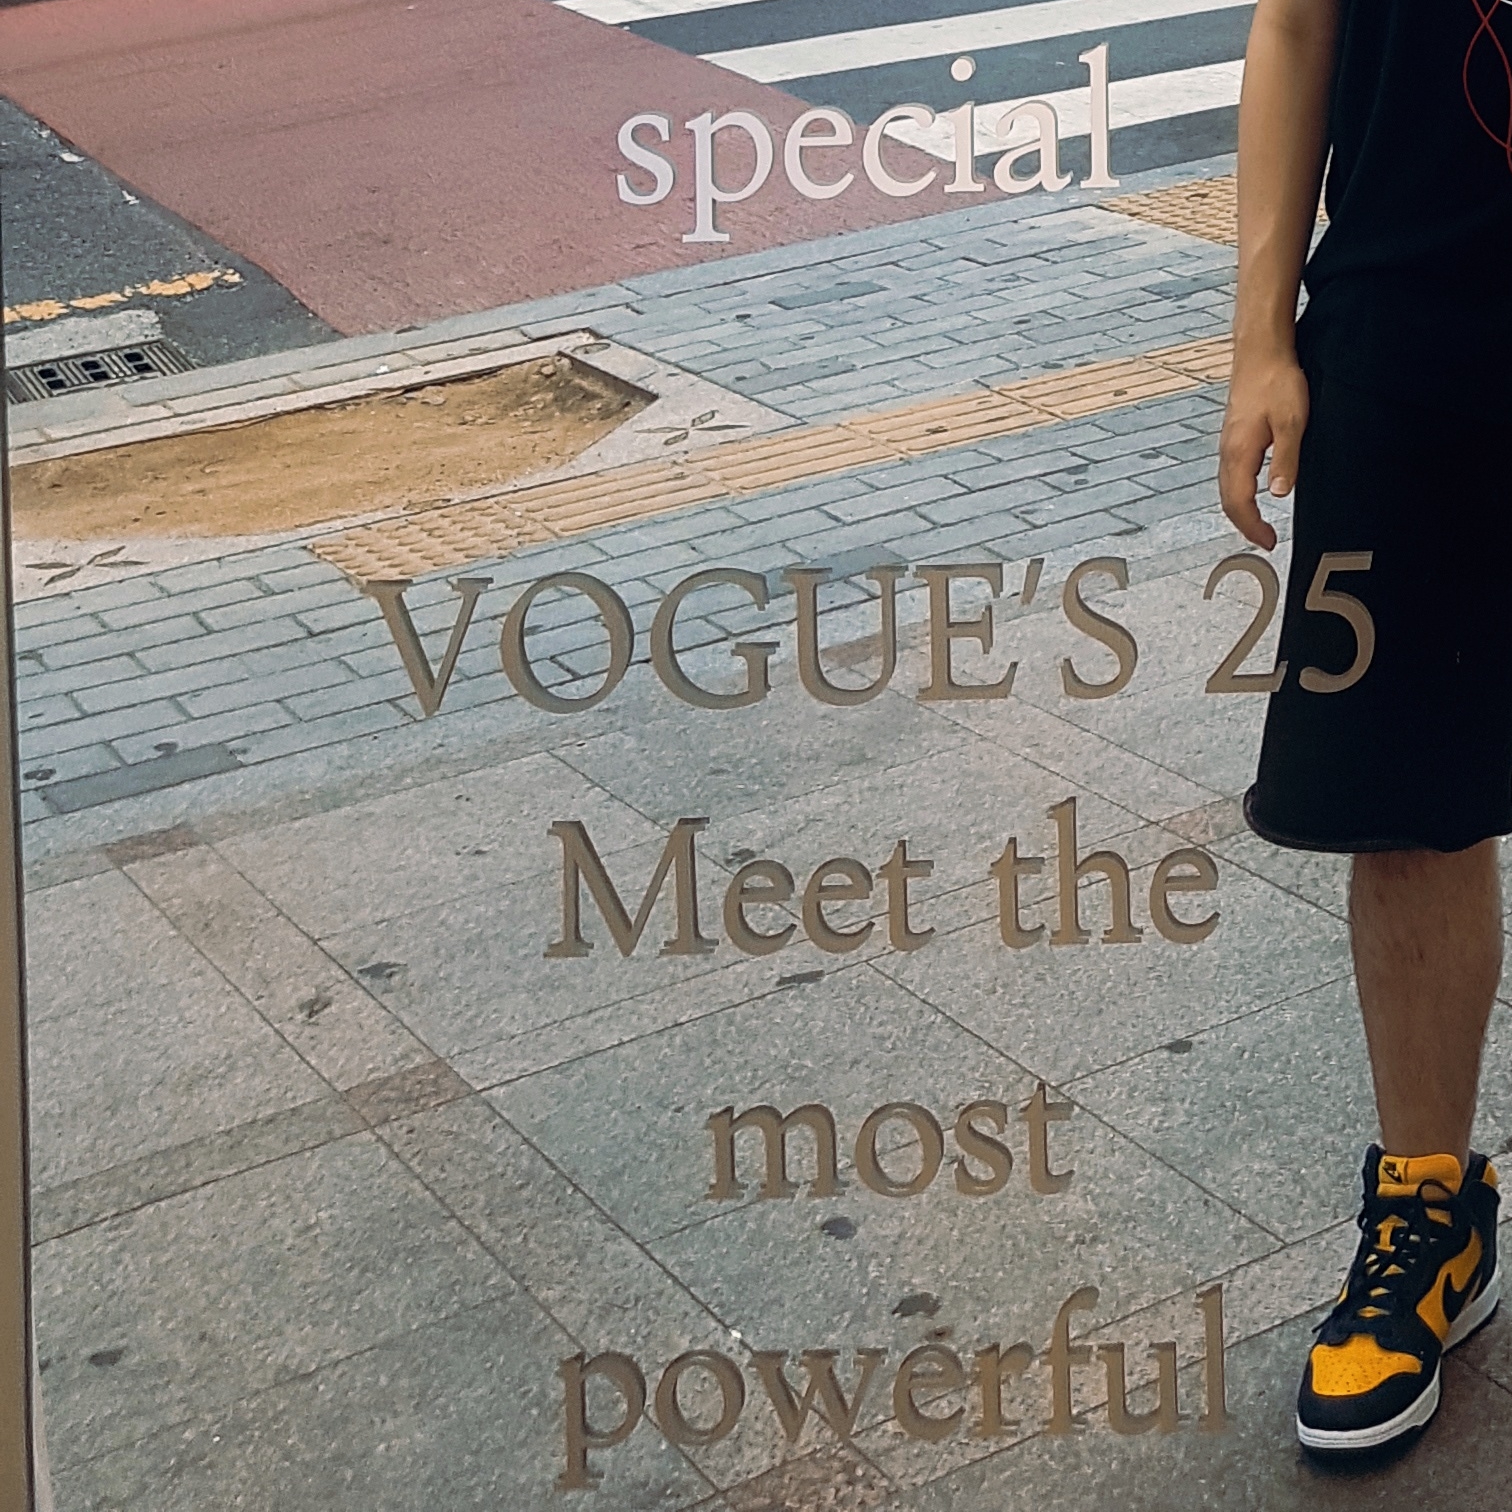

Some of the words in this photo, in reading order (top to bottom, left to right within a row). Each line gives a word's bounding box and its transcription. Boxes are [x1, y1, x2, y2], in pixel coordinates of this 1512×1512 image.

[617, 42, 1121, 243] special
[364, 555, 1140, 718] VOGUE'S
[1203, 551, 1377, 696] 25
[544, 815, 936, 959] Meet
[991, 797, 1221, 946] the
[704, 1083, 1075, 1201] most
[556, 1283, 1230, 1491] powerful
